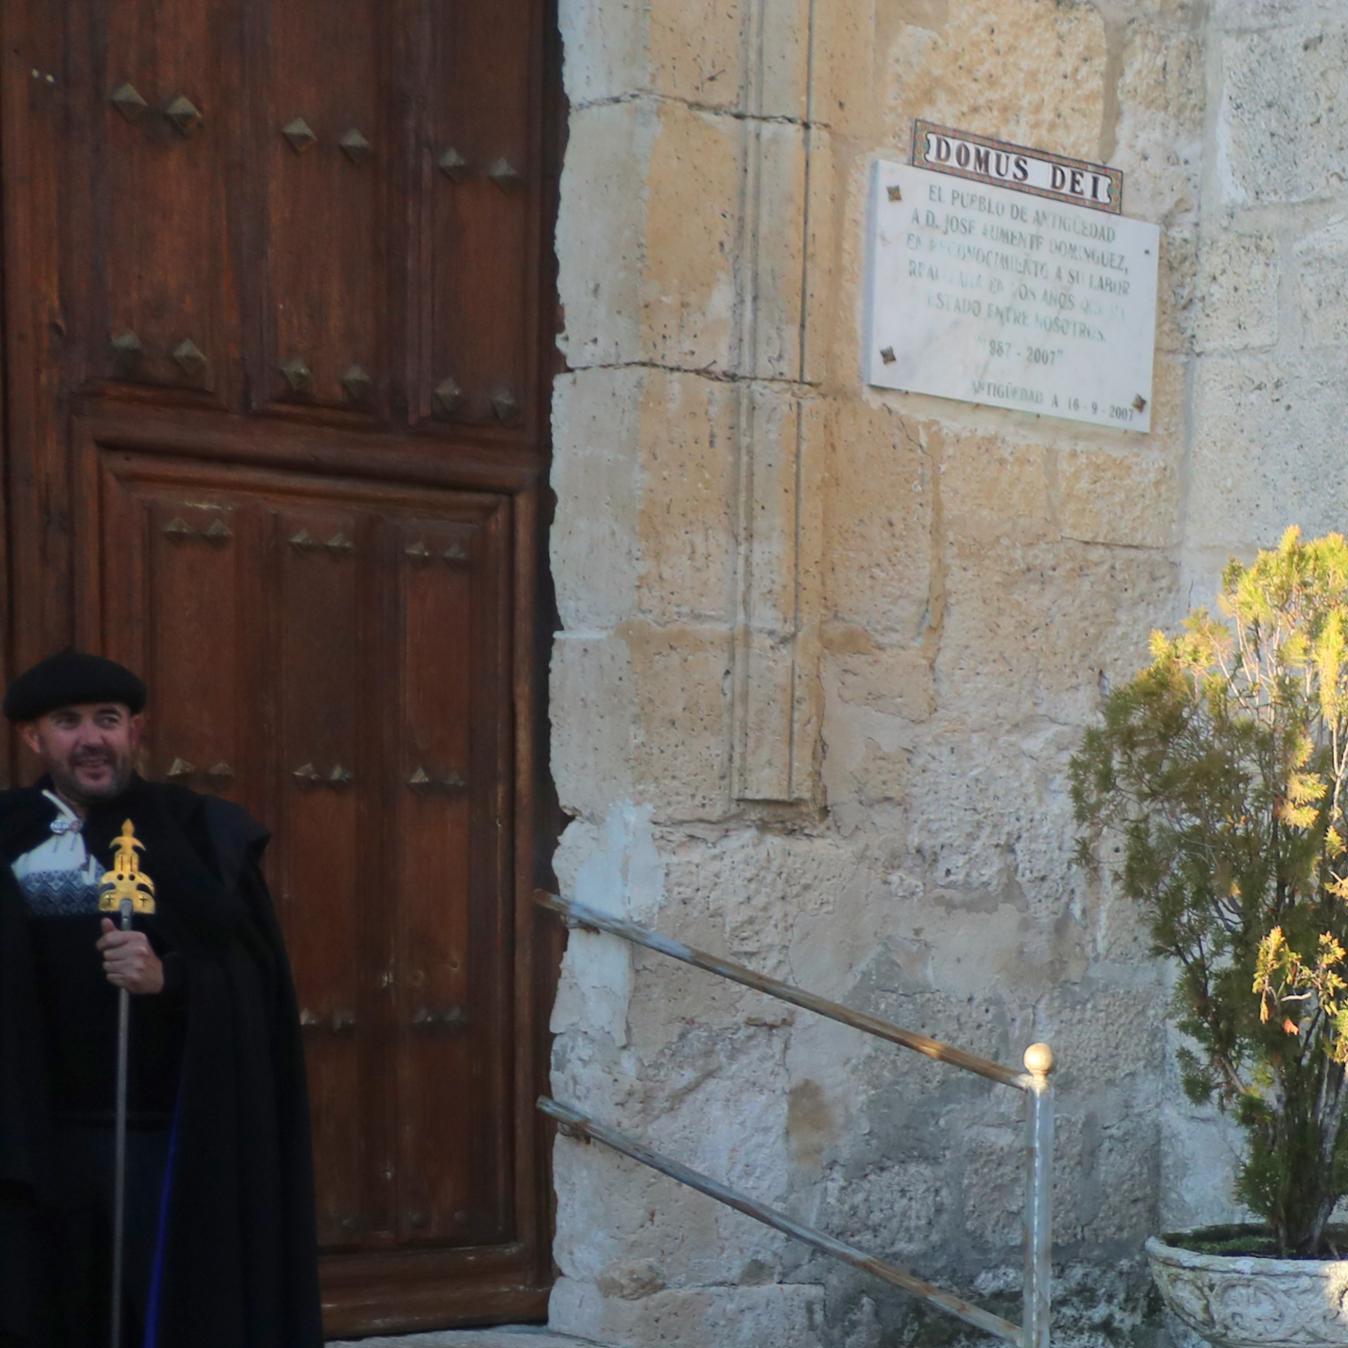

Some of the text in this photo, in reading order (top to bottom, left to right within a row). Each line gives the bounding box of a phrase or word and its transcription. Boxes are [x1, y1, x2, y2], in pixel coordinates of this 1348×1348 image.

[935, 136, 1100, 200] DOMUS DEI
[912, 208, 920, 224] A
[925, 210, 940, 229] D.
[929, 184, 943, 203] EL
[951, 189, 1005, 217] PUEBLO
[1010, 203, 1027, 223] DE
[929, 239, 1048, 279] RCONOCIMIENTO
[1056, 265, 1063, 281] A
[928, 288, 982, 317] ESTADO
[987, 303, 1029, 326] ENTRE
[1052, 394, 1059, 408] A
[1091, 401, 1098, 415] 9
[1110, 404, 1134, 422] 2007
